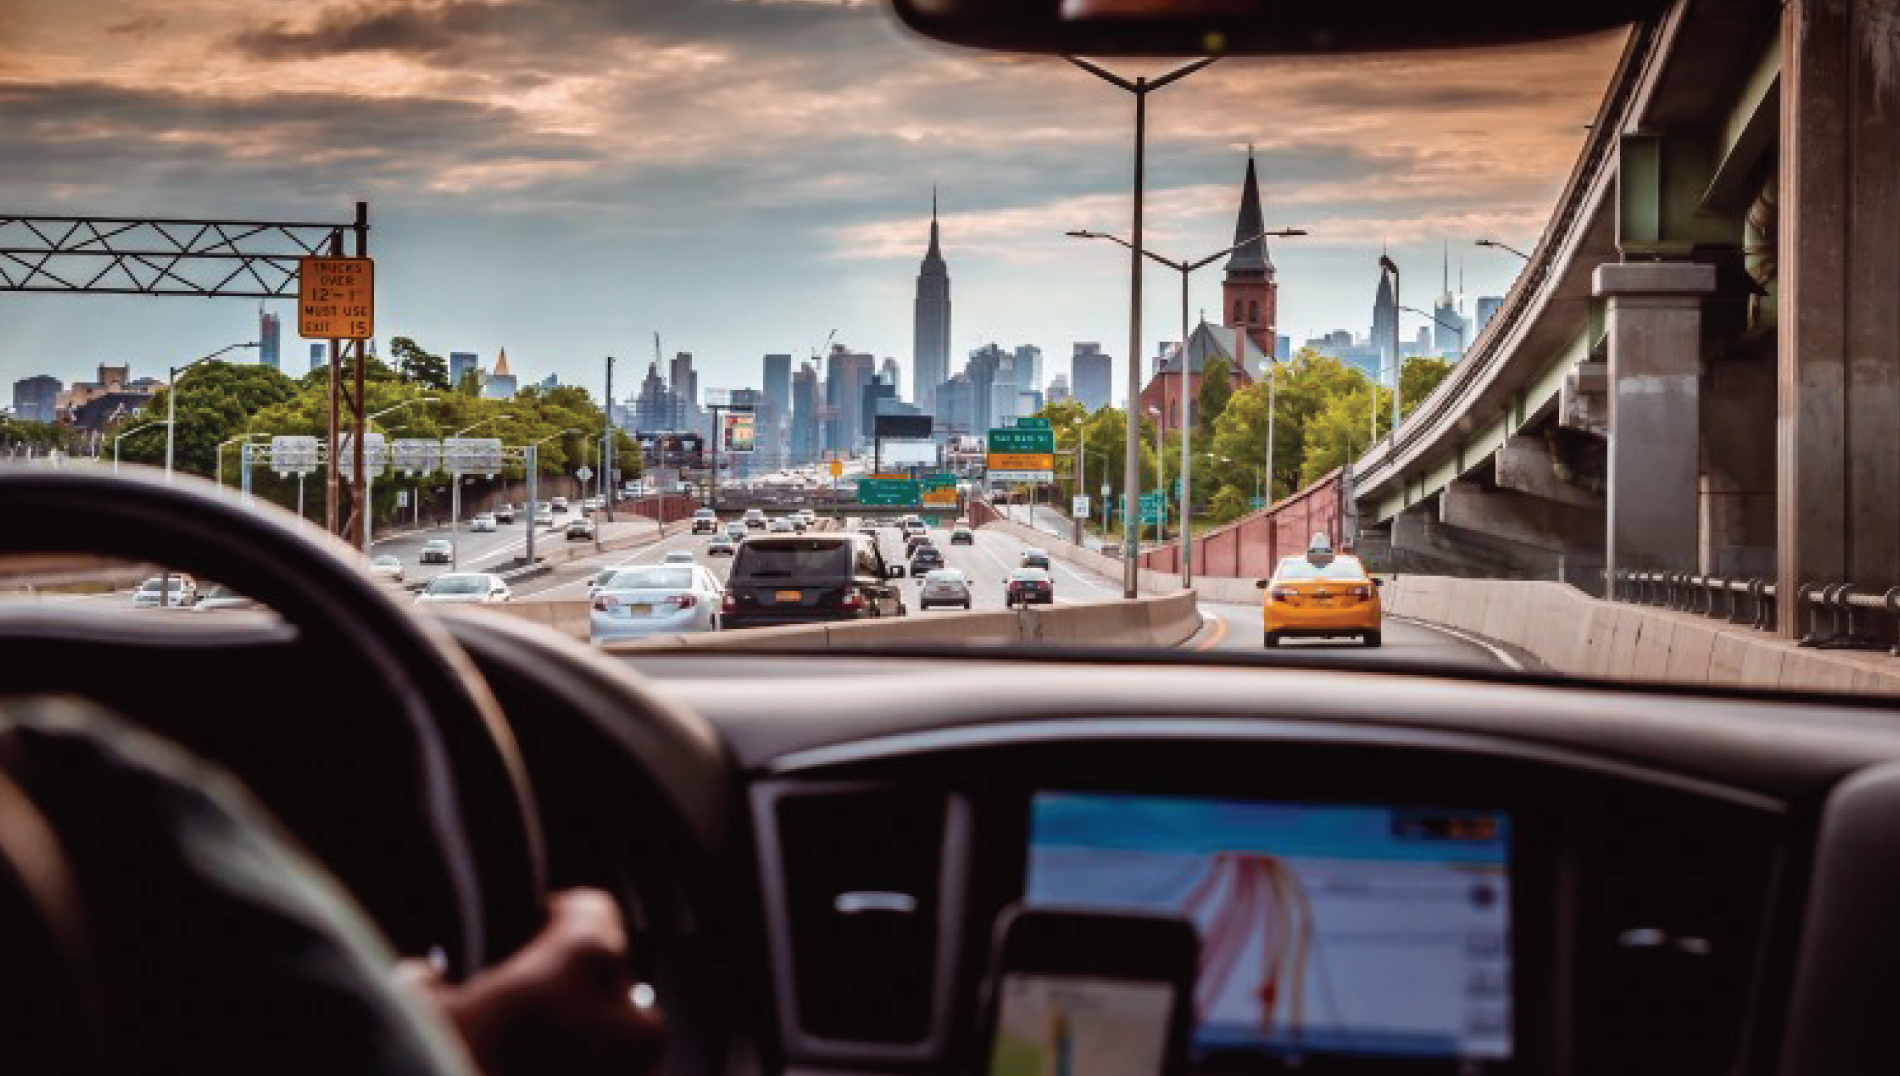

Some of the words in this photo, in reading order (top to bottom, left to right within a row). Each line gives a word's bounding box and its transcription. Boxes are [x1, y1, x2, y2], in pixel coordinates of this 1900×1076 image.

[313, 262, 362, 273] TRUCKS
[321, 275, 354, 286] OVER
[305, 305, 337, 316] MUST
[343, 305, 367, 316] USE
[305, 321, 329, 332] EXIT
[350, 321, 367, 335] 15
